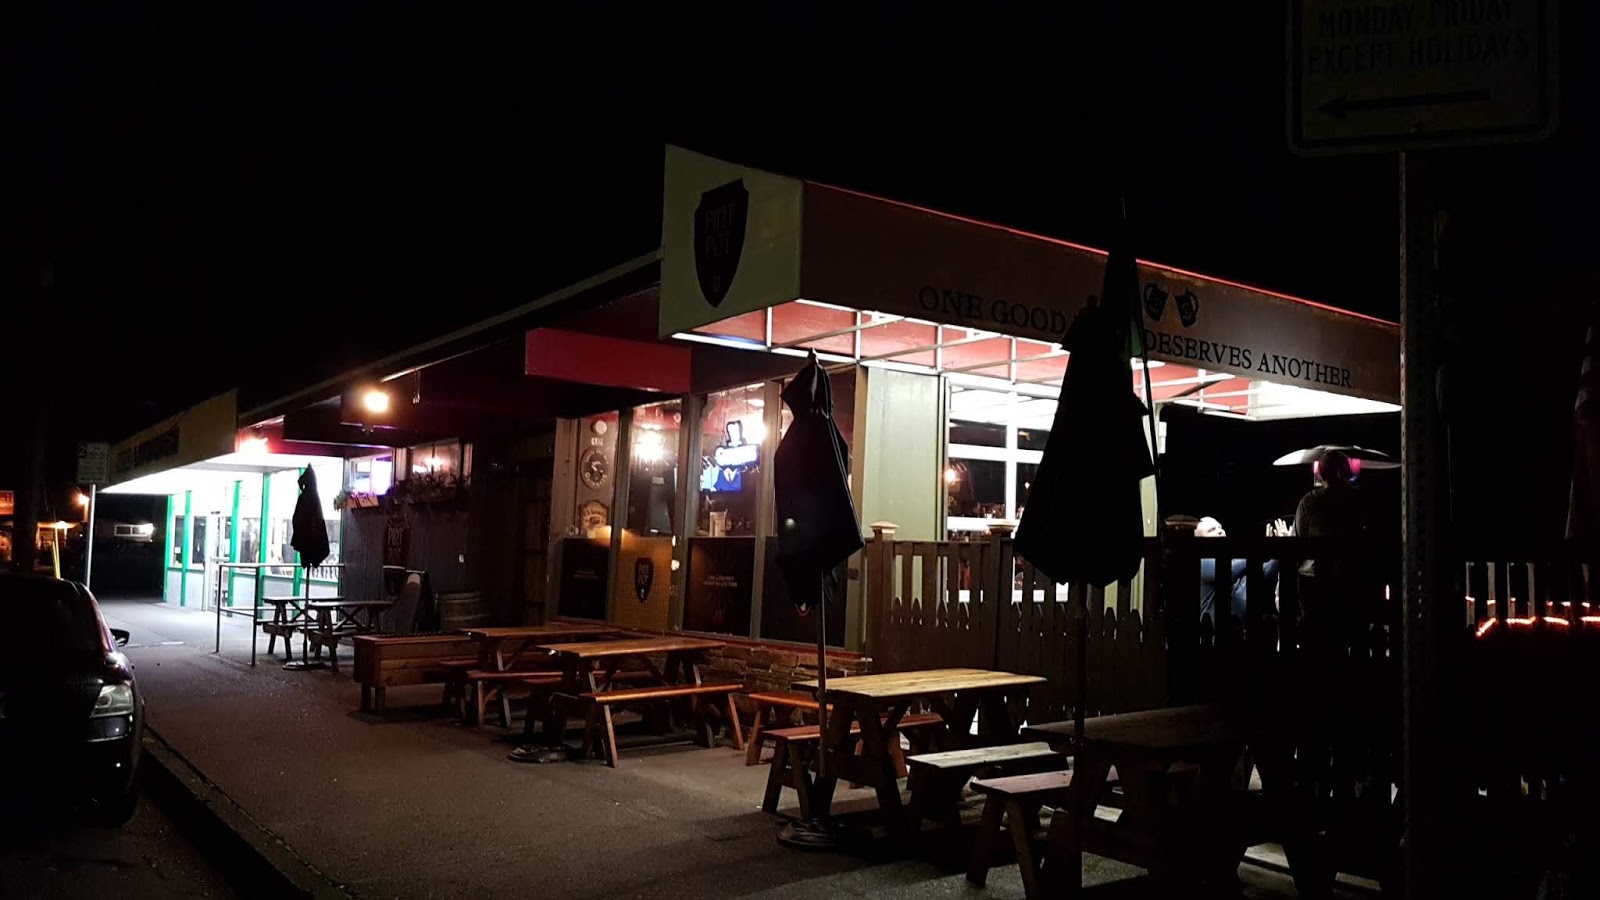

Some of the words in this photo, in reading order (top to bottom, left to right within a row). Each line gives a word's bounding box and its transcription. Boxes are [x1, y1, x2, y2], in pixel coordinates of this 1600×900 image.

[1308, 41, 1395, 75] EXCEPT
[1408, 29, 1530, 67] HOLIDAYS
[705, 230, 732, 258] POT
[918, 285, 983, 319] ONE
[991, 299, 1067, 334] GOOD
[1143, 329, 1252, 370] DESERVES
